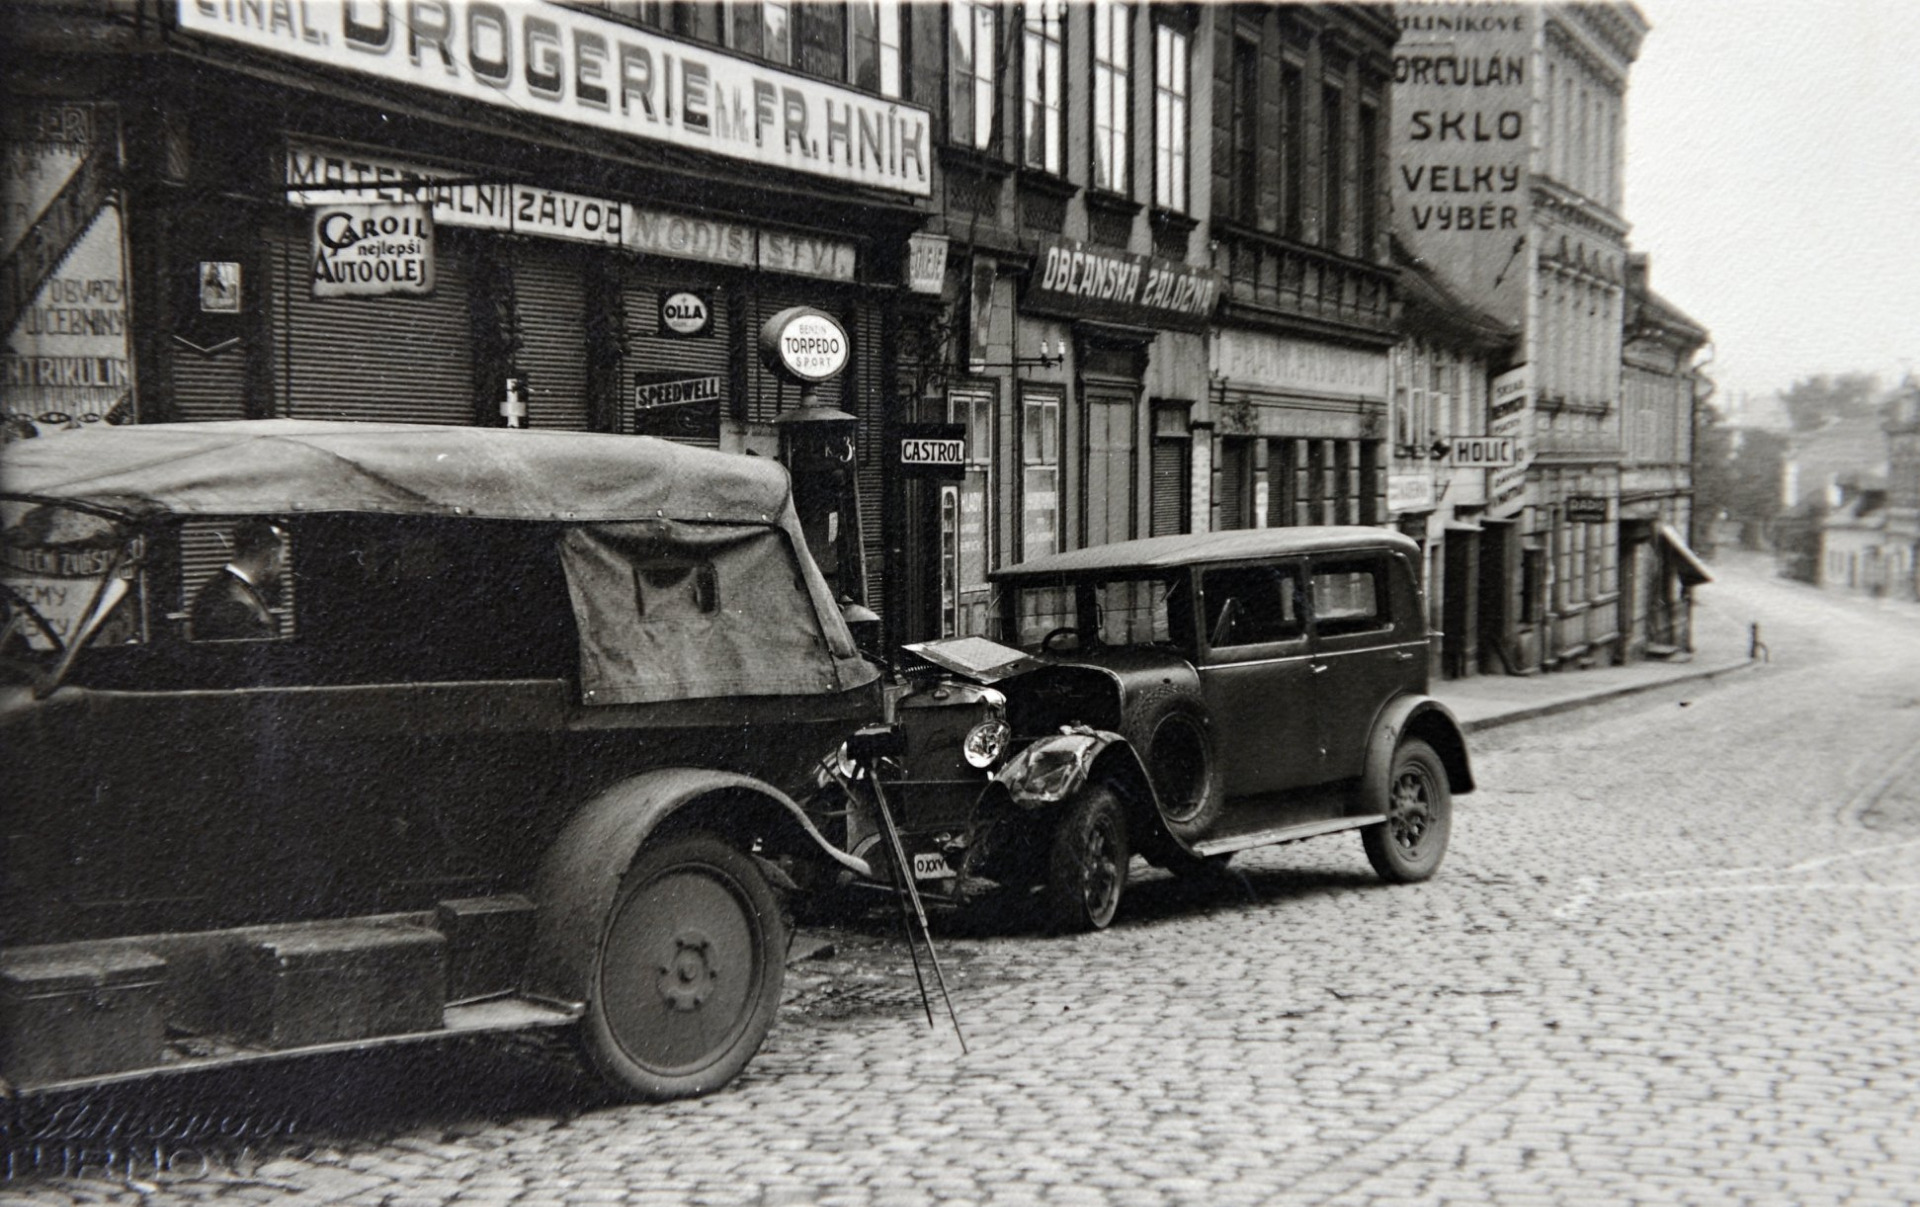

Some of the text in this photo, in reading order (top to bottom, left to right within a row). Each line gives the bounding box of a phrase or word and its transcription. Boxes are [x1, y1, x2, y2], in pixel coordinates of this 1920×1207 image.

[197, 0, 330, 46] NAL.
[343, 0, 712, 136] DROGERIE
[752, 78, 820, 160] FR.
[825, 97, 926, 182] HNÍK
[1410, 111, 1522, 141] SKLO
[518, 190, 621, 234] ZÁVOD
[317, 211, 428, 257] CAROIL
[665, 305, 704, 319] OLLA
[799, 324, 827, 335] BENZIN
[785, 337, 839, 354] TORPEDO
[796, 357, 831, 367] SPORT
[638, 378, 719, 407] SPEEDWELL
[903, 441, 963, 463] CASTROL
